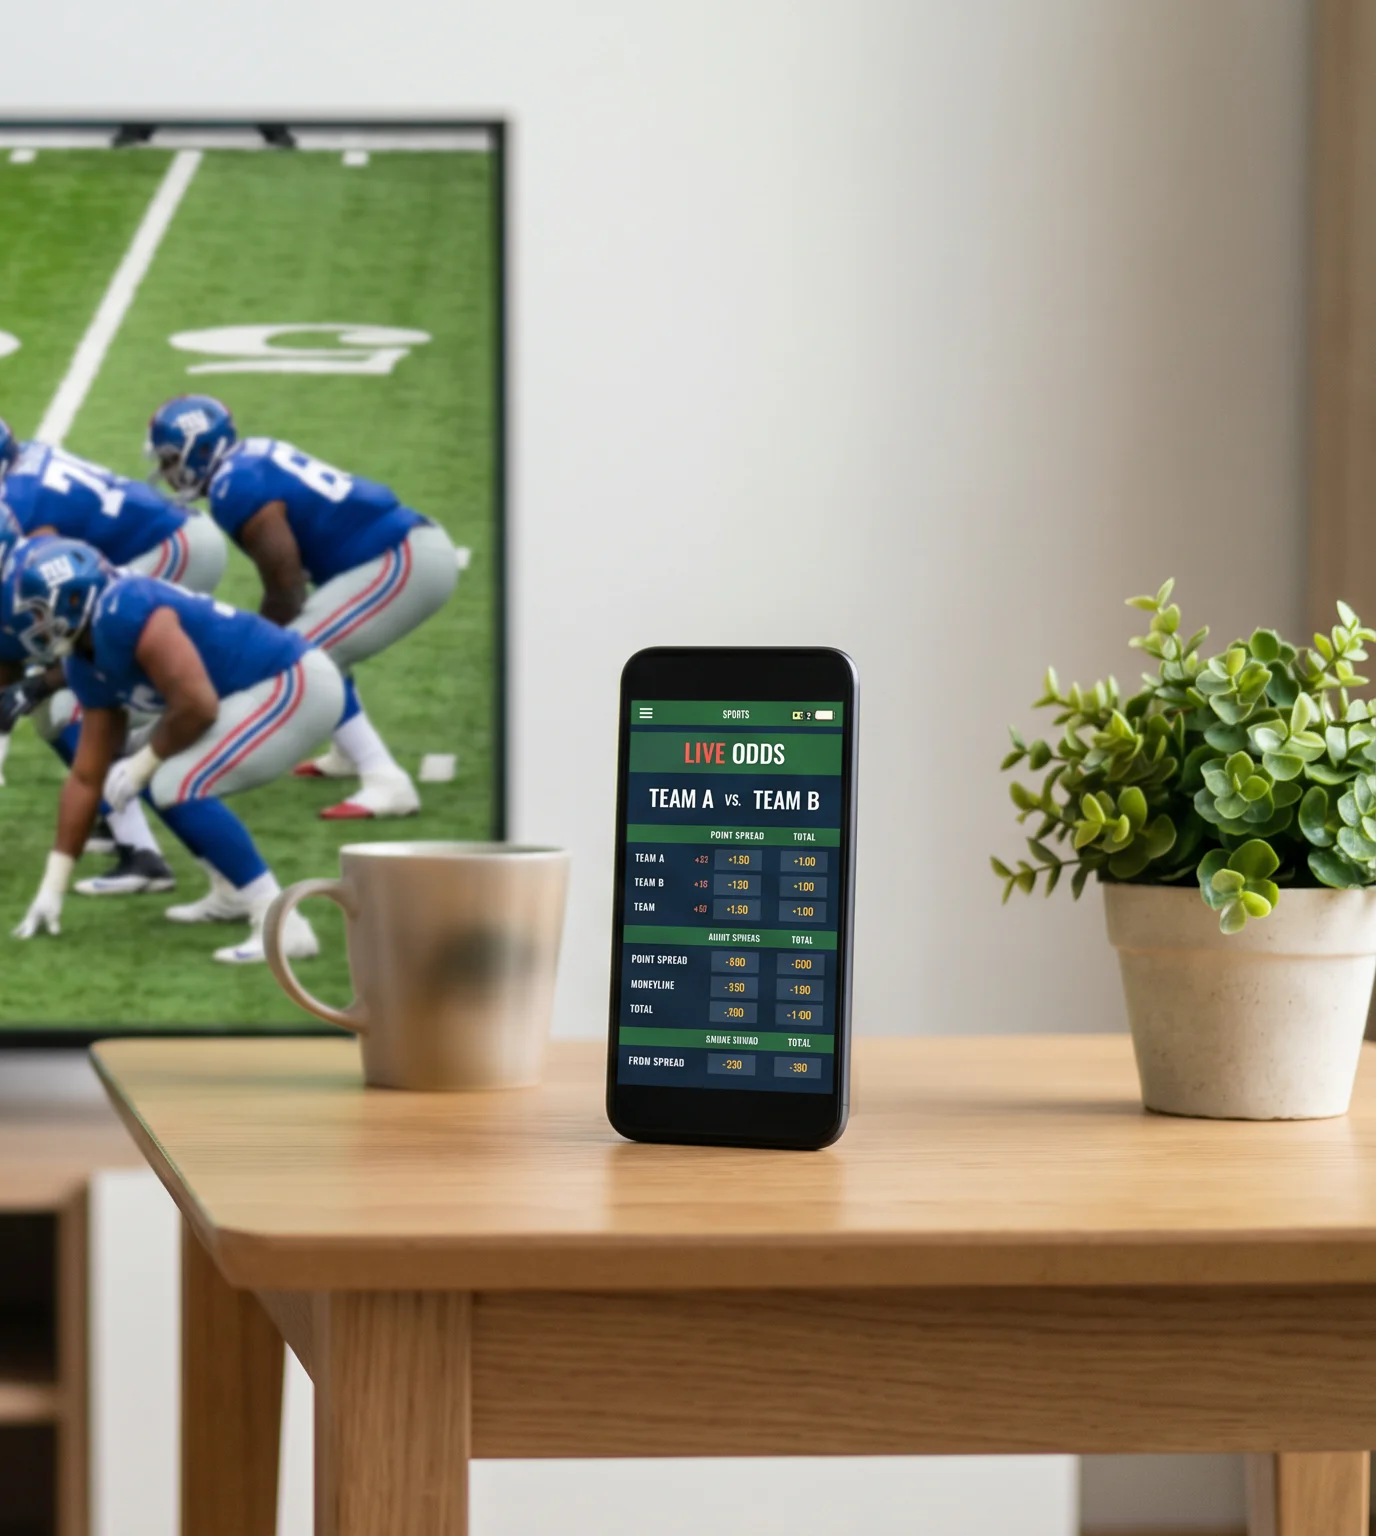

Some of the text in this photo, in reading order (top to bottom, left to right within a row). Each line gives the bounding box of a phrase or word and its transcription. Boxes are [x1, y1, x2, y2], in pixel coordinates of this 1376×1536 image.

[723, 710, 749, 718] SPORTS
[685, 742, 785, 764] LIVE ODDS
[649, 789, 819, 810] TEAM A VS. TEAM B
[711, 831, 733, 839] POINT
[794, 833, 815, 841] TOTAL
[636, 854, 664, 862] TEAM A
[635, 878, 664, 887] TEAM B
[634, 903, 655, 911] TEAM
[632, 955, 654, 963] POINT
[630, 1004, 653, 1013] TOTAL
[654, 1058, 684, 1067] SPREAD
